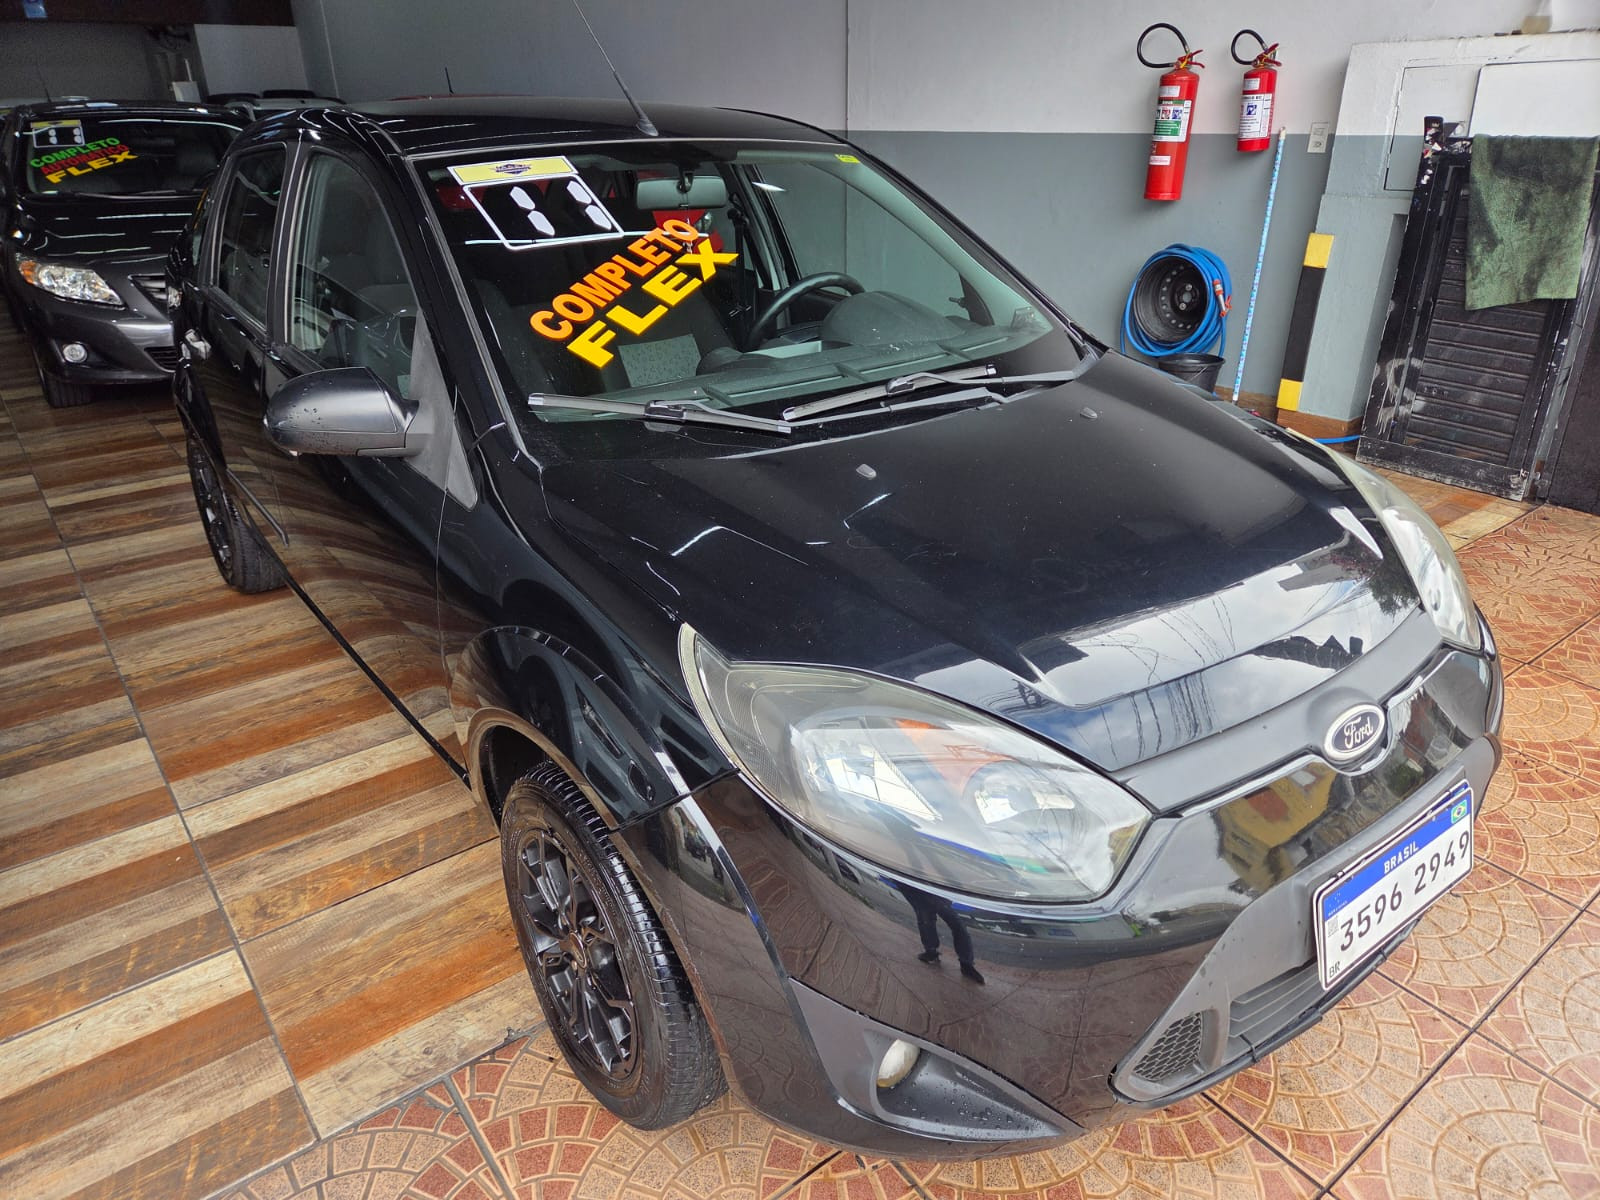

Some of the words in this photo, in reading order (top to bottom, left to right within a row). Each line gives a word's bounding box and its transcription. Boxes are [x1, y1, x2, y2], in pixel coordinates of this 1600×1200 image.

[30, 137, 120, 168] COMPLETO
[46, 150, 139, 184] FLEX
[529, 218, 700, 341] COMPLETO
[566, 239, 739, 369] FLEX
[1343, 716, 1374, 749] Ford
[1383, 841, 1419, 874] BRASIL
[1340, 882, 1402, 952] 3596
[1414, 830, 1470, 895] 2949
[1329, 960, 1341, 978] BR
